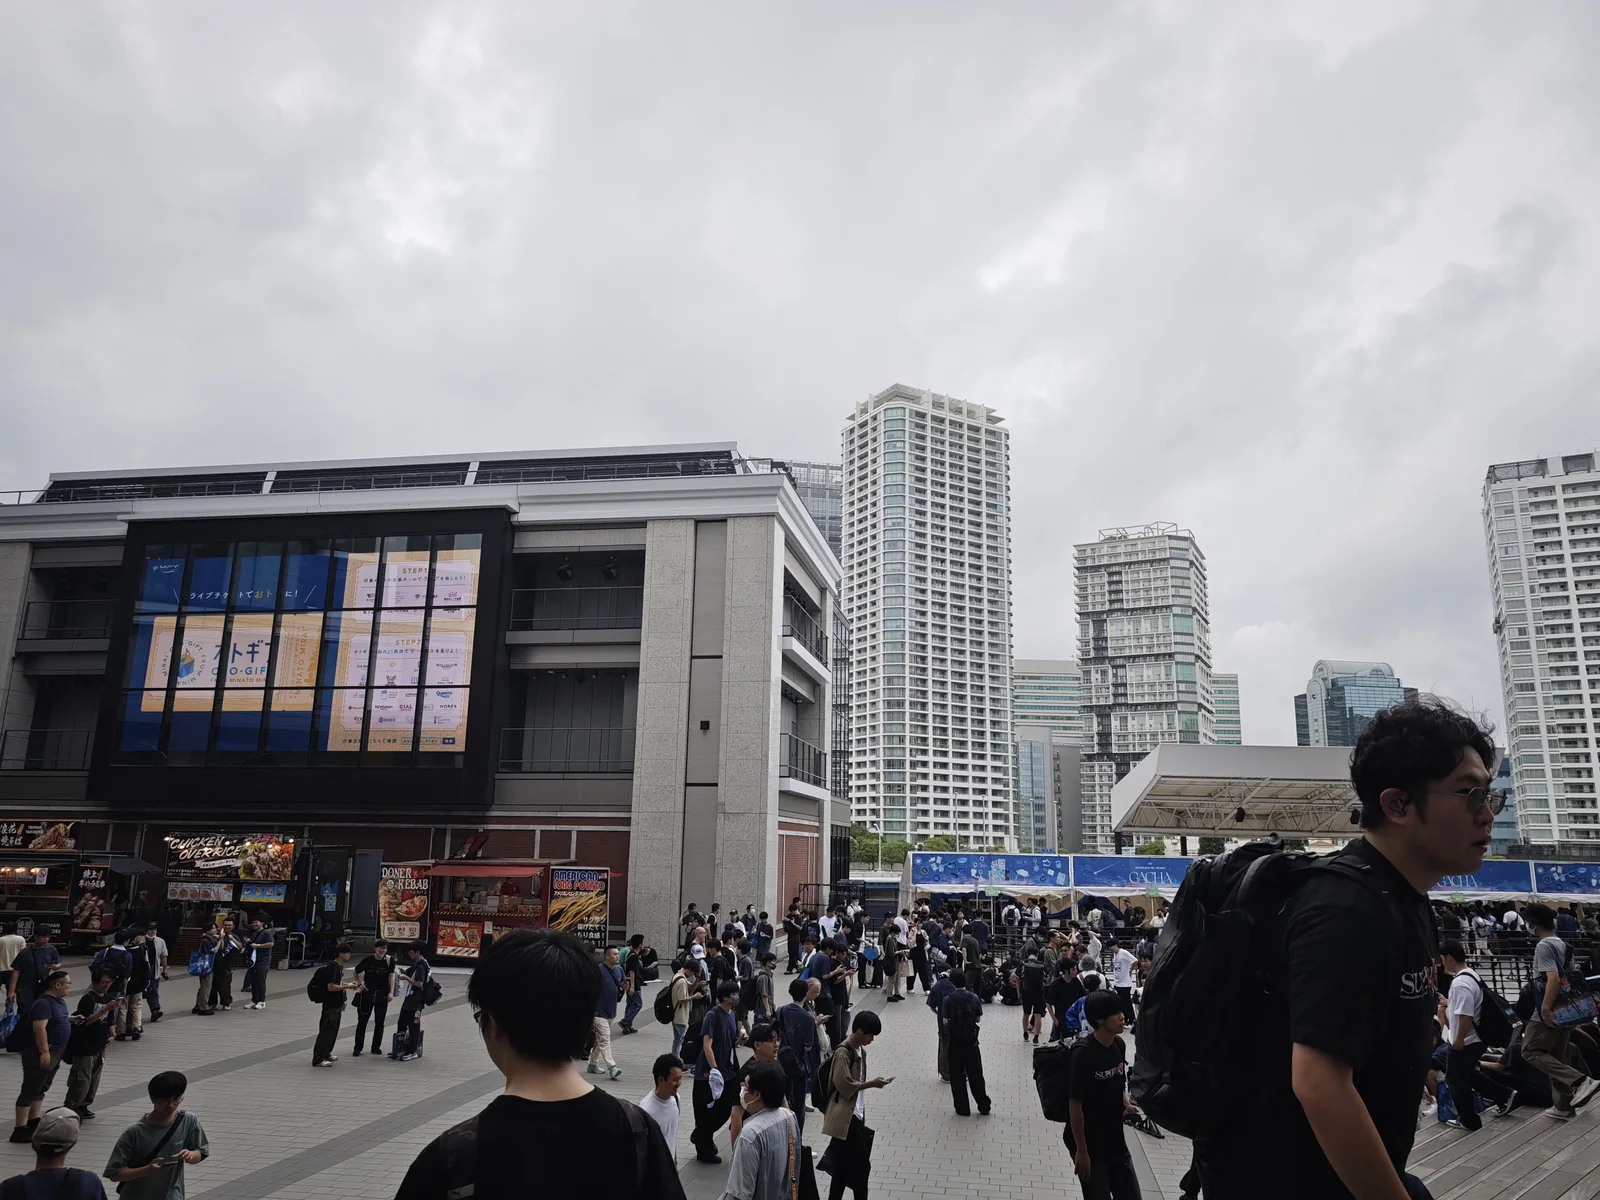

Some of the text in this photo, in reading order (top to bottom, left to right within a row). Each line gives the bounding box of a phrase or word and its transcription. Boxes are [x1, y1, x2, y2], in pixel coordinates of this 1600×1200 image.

[170, 836, 225, 850] CHICKEN
[381, 867, 412, 878] DONER
[554, 870, 598, 881] AMERICAN
[1128, 871, 1173, 884] GACHA
[398, 878, 429, 890] KEBAB
[553, 880, 606, 891] LONG POTATO
[1437, 874, 1478, 888] GACHA
